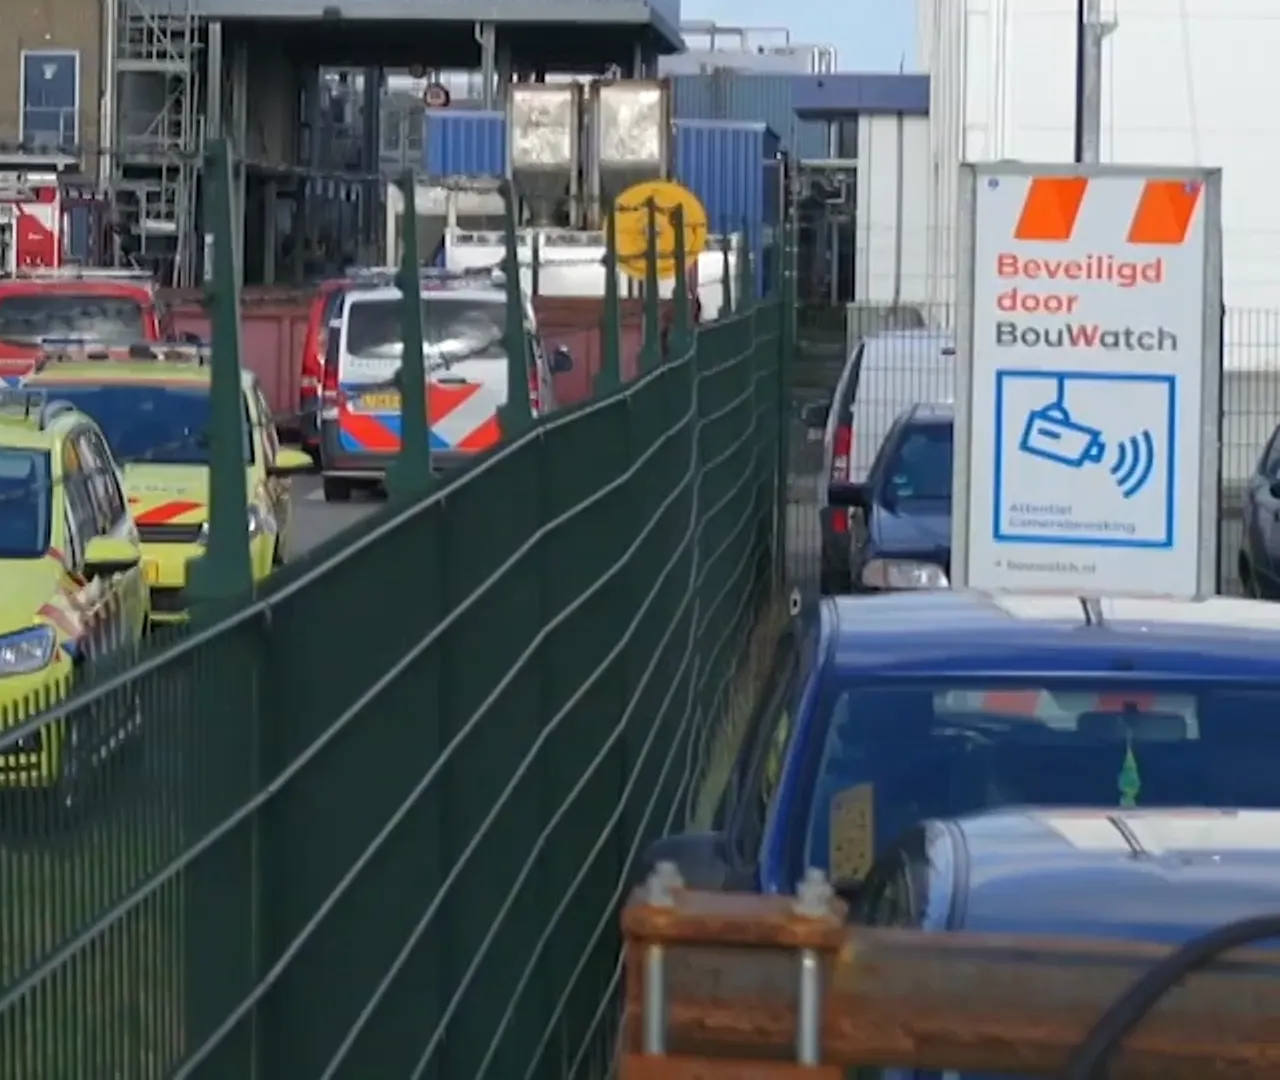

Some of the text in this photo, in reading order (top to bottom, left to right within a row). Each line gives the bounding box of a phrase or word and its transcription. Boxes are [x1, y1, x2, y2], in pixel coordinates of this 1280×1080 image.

[996, 252, 1162, 287] Beveiligd
[996, 287, 1078, 313] door
[995, 321, 1178, 351] BouWatch
